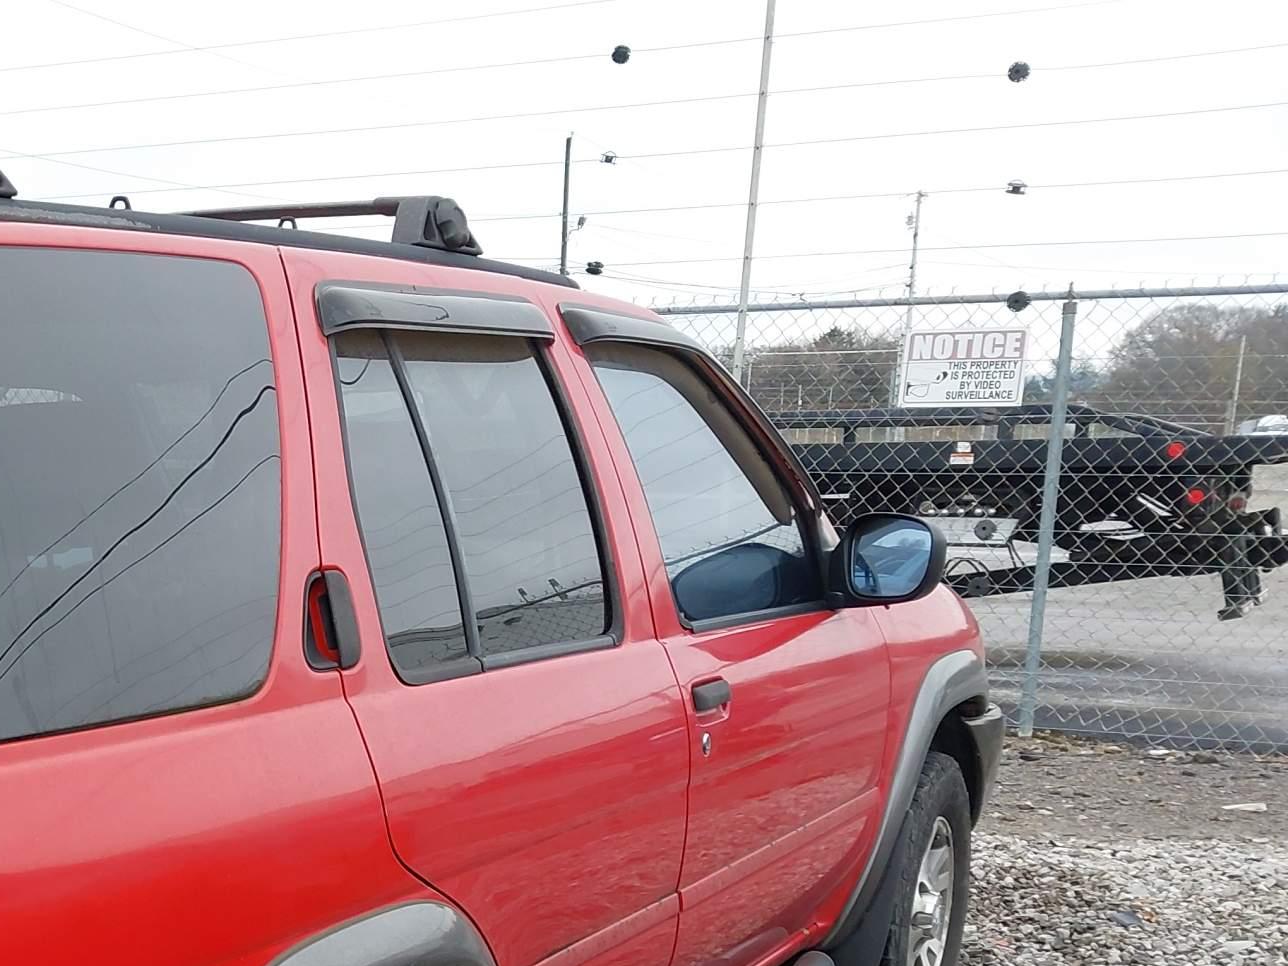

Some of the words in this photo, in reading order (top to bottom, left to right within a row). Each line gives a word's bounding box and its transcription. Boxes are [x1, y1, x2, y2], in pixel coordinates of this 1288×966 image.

[912, 332, 1023, 360] NOTICE
[948, 361, 968, 370] THIS
[969, 360, 1019, 369] PROPERTY
[950, 371, 959, 380] IS
[961, 370, 1015, 380] PROTECTED
[959, 381, 971, 390] BY
[974, 380, 1001, 390] VIDEO
[945, 390, 1013, 400] SURVEILLANCE
